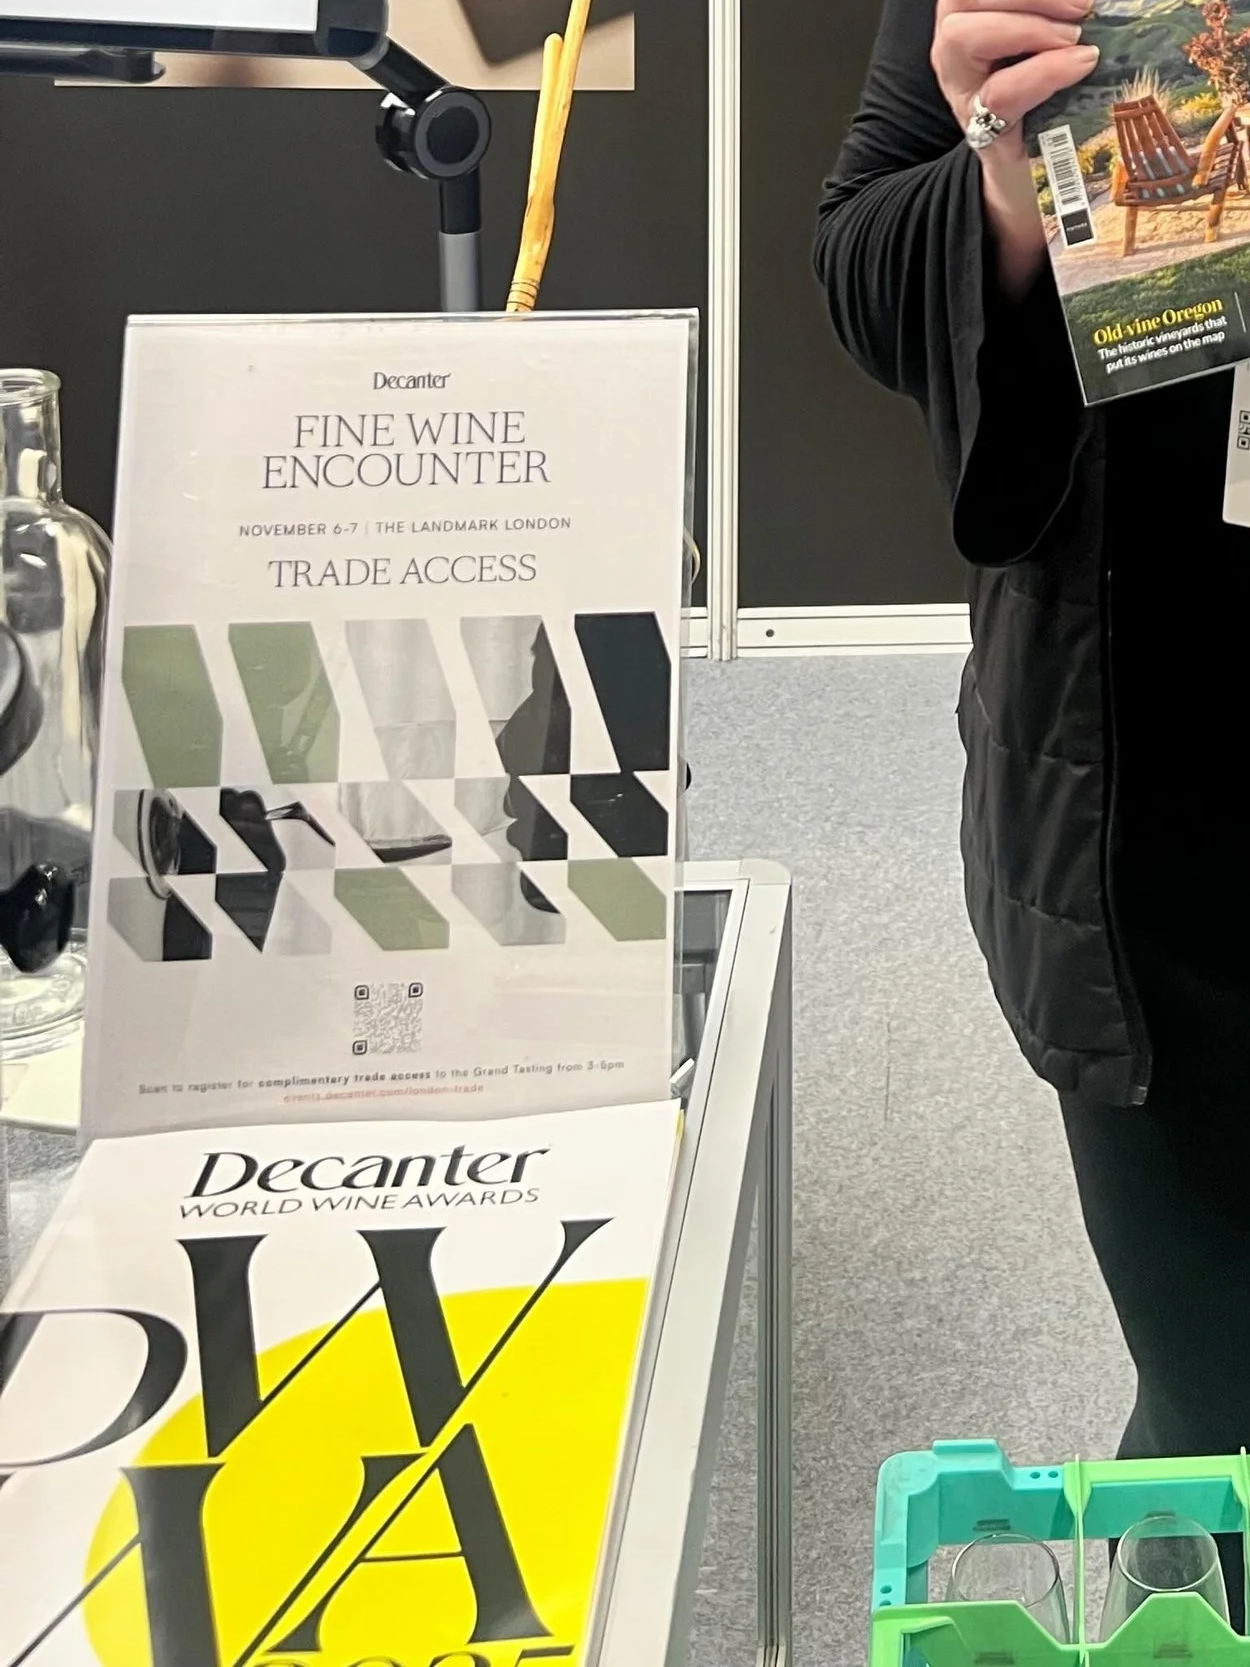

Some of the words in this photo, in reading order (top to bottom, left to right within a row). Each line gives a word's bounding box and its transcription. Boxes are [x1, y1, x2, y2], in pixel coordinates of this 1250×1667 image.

[1093, 315, 1162, 346] Old-vine
[1162, 297, 1223, 327] Oregon
[1098, 346, 1118, 361] The
[1118, 336, 1155, 355] historic
[1155, 322, 1204, 347] vineyards
[1204, 315, 1228, 331] that
[1105, 359, 1124, 375] put
[1124, 354, 1138, 369] its
[1138, 347, 1168, 364] wines
[1169, 343, 1183, 356] on
[1183, 336, 1201, 351] the
[1202, 331, 1226, 350] map
[373, 371, 451, 391] Decanter
[293, 412, 395, 450] FINE
[406, 410, 526, 446] WINE
[261, 449, 552, 490] ENCOUNTER
[239, 522, 327, 538] NOVEMBER
[333, 521, 358, 536] 6-7
[376, 520, 405, 534] THE
[411, 518, 499, 533] LANDMARK
[505, 515, 571, 532] LONDON
[268, 556, 392, 589] TRADE
[399, 553, 538, 586] ACCESS
[138, 1082, 168, 1095] Scan
[172, 1082, 184, 1093] to
[188, 1081, 233, 1094] register
[237, 1079, 254, 1090] for
[258, 1074, 349, 1089] complimentary
[354, 1071, 386, 1083] trade
[390, 1069, 432, 1082] access
[435, 1068, 447, 1079] to
[451, 1067, 469, 1078] the
[473, 1065, 509, 1077] Grand
[513, 1063, 553, 1076] Tasting
[557, 1062, 583, 1074] from
[184, 1144, 551, 1200] Decanter
[179, 1197, 303, 1220] WORLD
[312, 1193, 397, 1213] WINE
[402, 1187, 540, 1211] AWARDS
